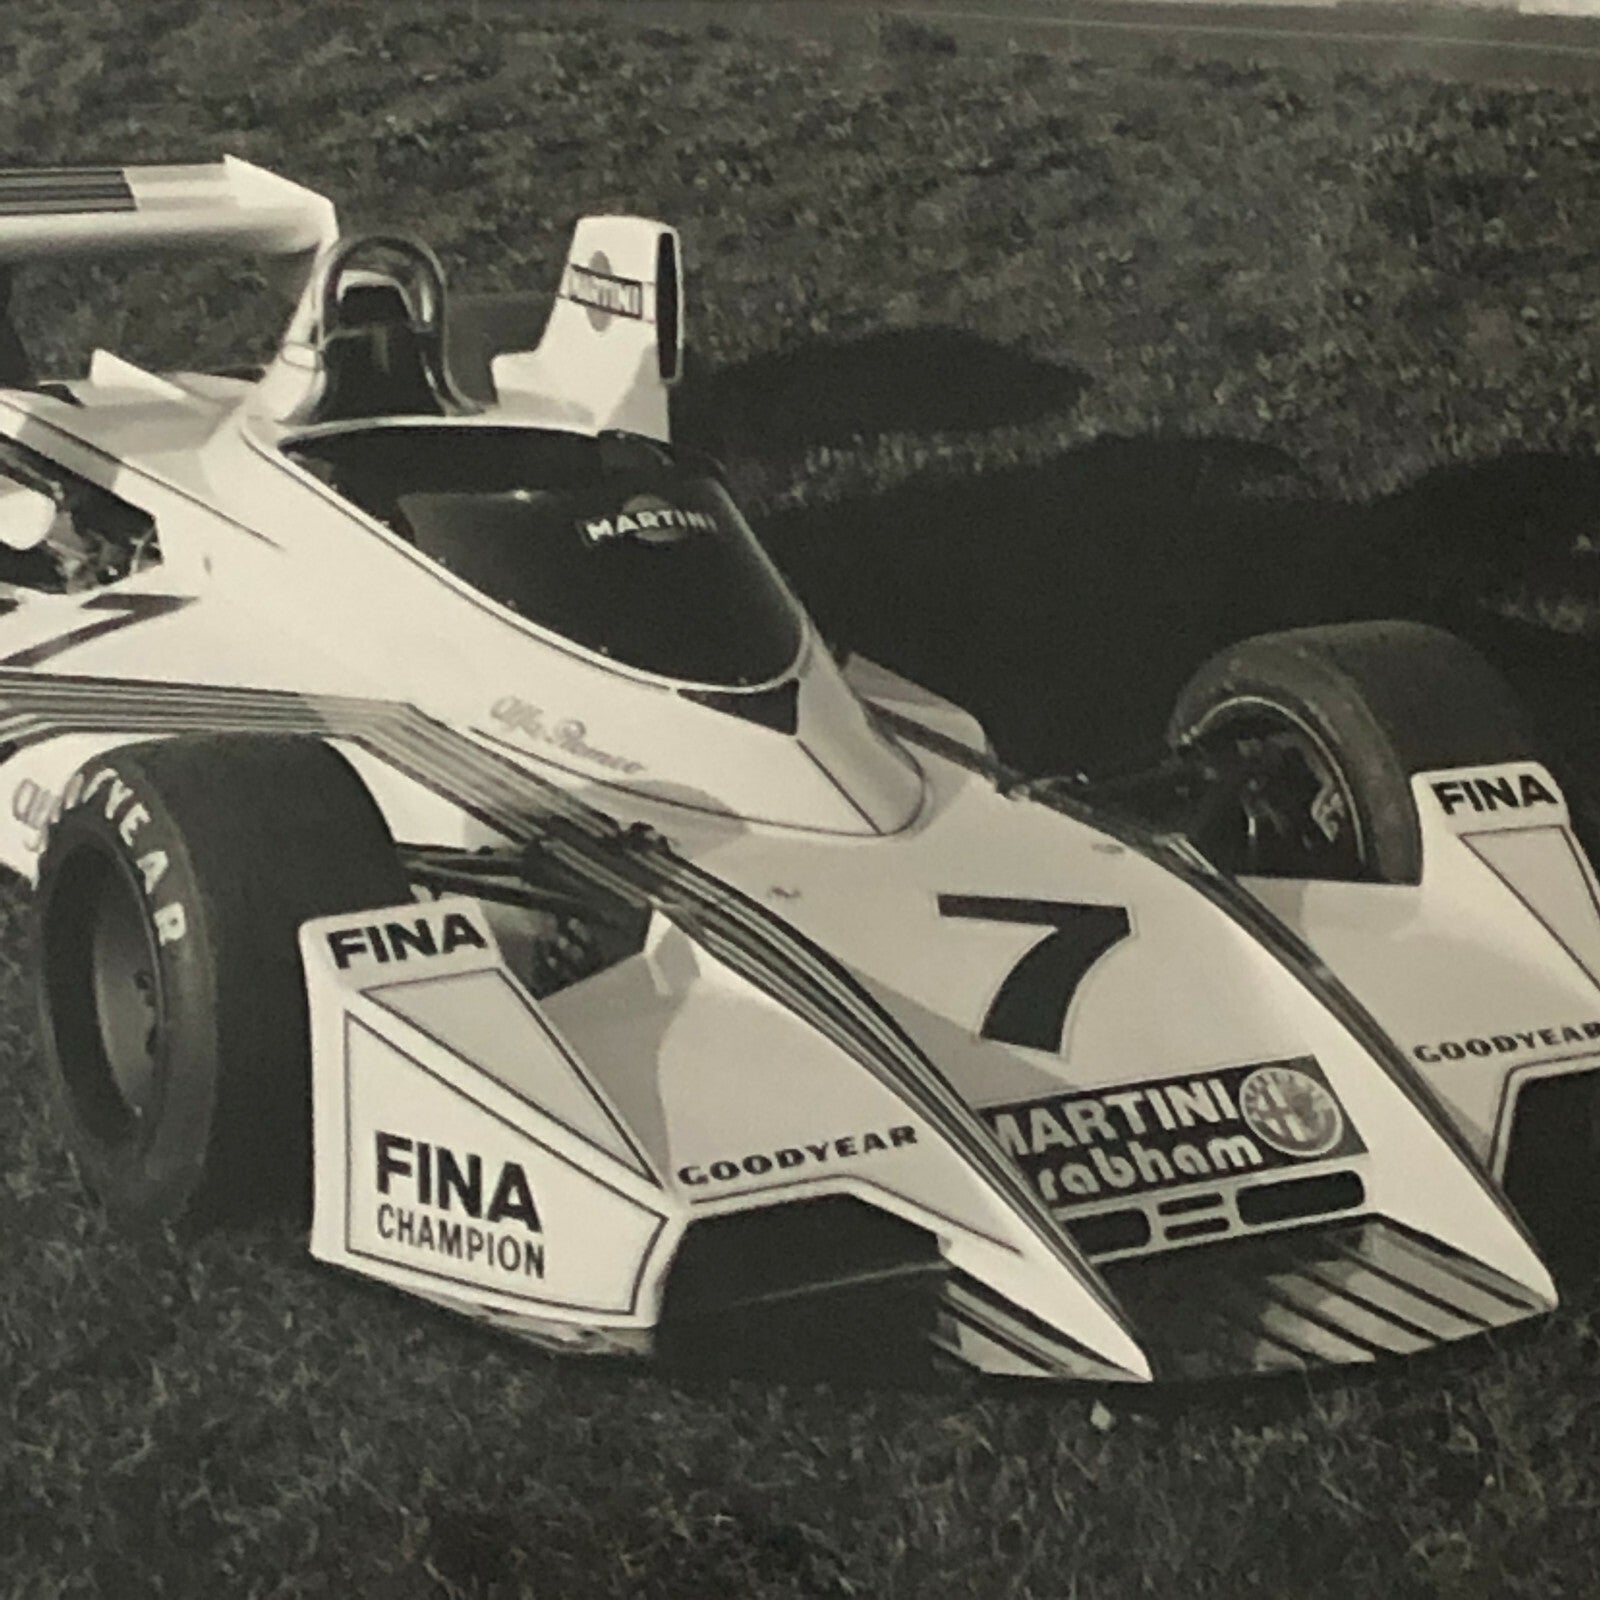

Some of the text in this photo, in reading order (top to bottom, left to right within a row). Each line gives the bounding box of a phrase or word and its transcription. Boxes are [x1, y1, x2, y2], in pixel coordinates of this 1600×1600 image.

[586, 509, 717, 541] MARTINI
[1430, 774, 1559, 815] FINA
[327, 913, 488, 970] FINA
[937, 893, 1131, 1055] 7
[375, 1129, 543, 1234] FINA
[677, 1125, 918, 1186] GOODYEAR
[1037, 1133, 1263, 1200] rabham
[377, 1202, 544, 1279] CHAMPION
